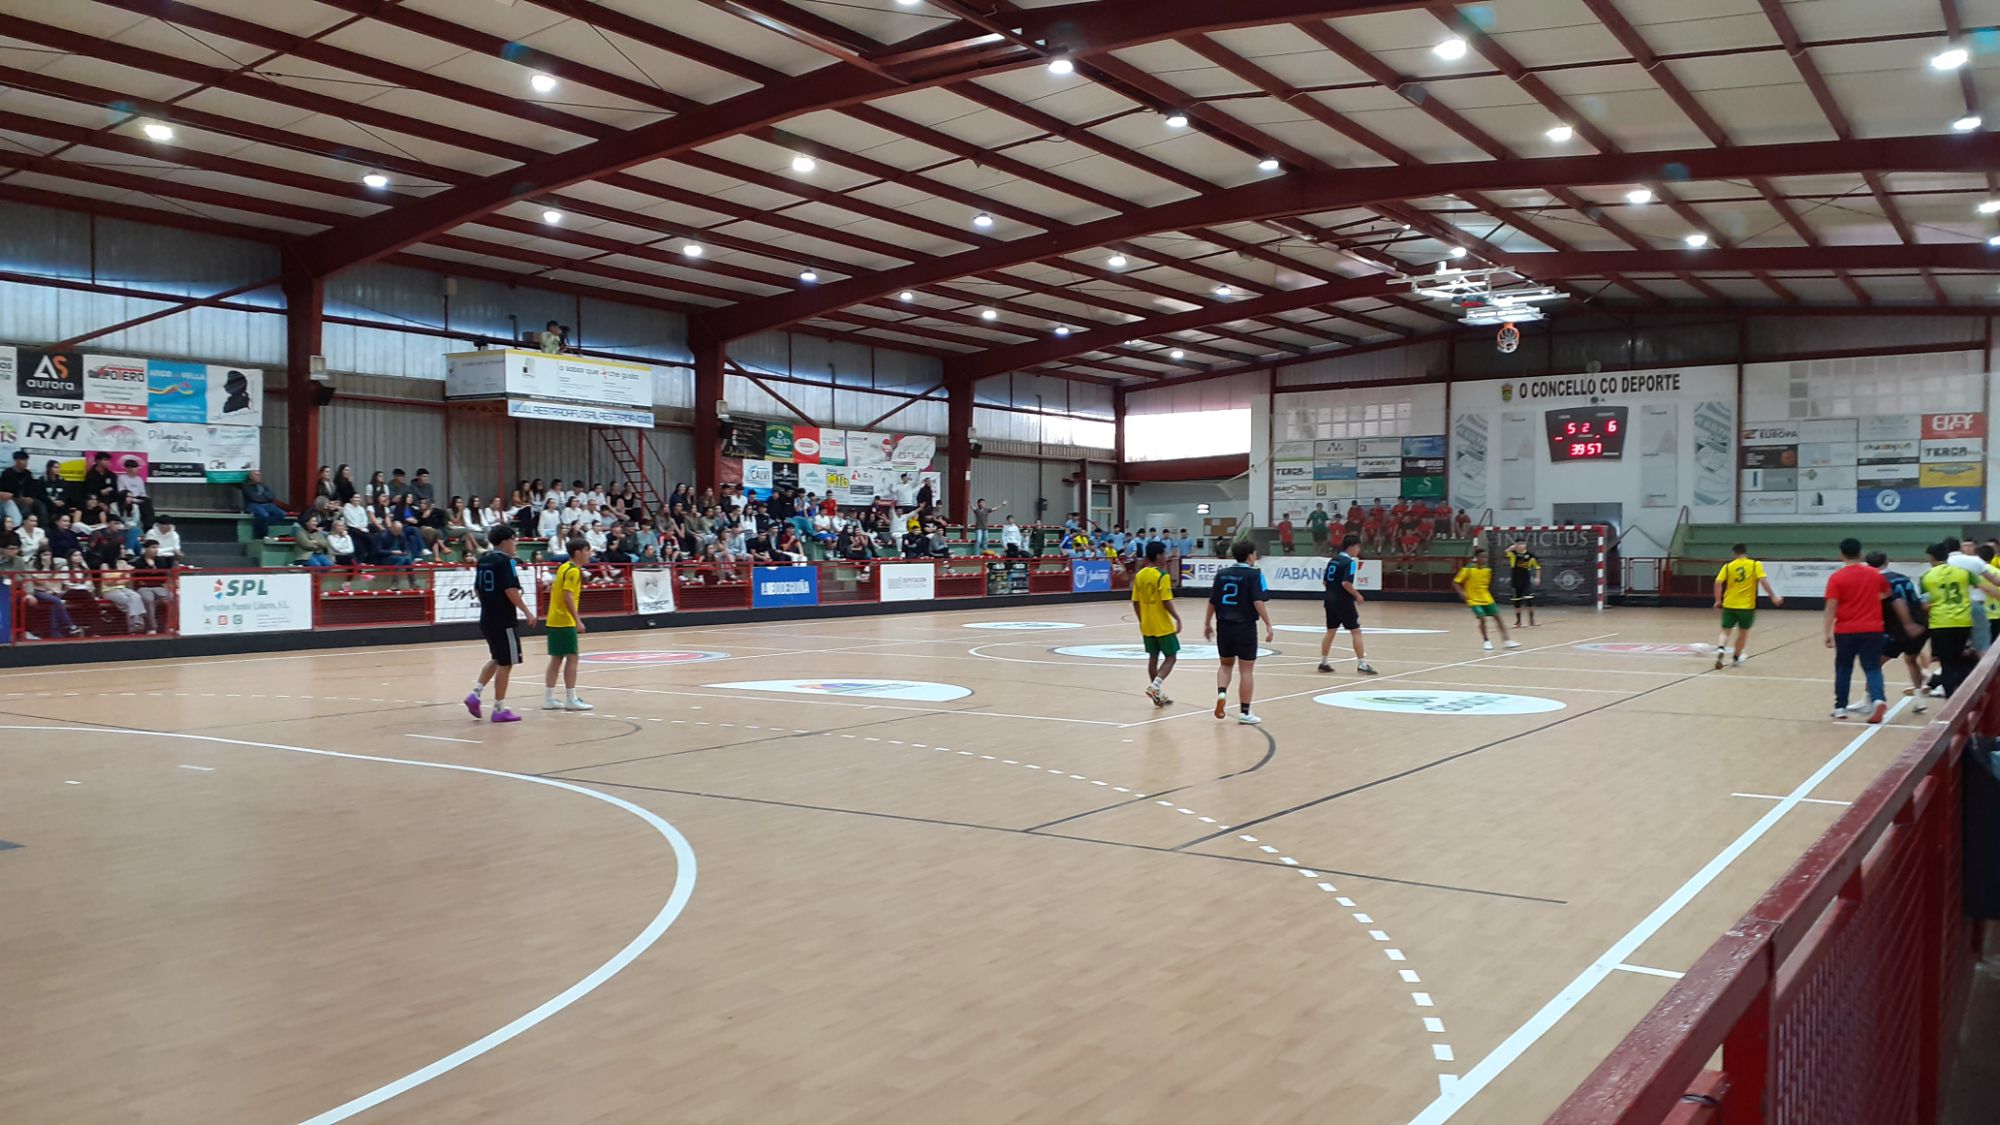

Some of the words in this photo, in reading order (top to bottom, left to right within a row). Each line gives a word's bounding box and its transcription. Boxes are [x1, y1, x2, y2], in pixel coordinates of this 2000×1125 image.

[26, 379, 76, 391] aurora
[1519, 383, 1528, 399] O
[1531, 378, 1596, 398] CONCELLO
[1600, 376, 1618, 394] CO
[1621, 373, 1681, 393] DEPORTE
[20, 400, 81, 411] DEQUIP
[26, 422, 79, 441] RM
[1568, 423, 1576, 435] 5
[1581, 422, 1591, 434] 2
[1608, 420, 1617, 433] 6
[1759, 431, 1799, 440] EUROPA
[1496, 531, 1589, 546] INVICTUS
[1327, 565, 1336, 581] 8
[1734, 567, 1746, 583] 3
[226, 579, 269, 597] SPL
[1222, 583, 1238, 605] 2
[1939, 582, 1962, 604] 13
